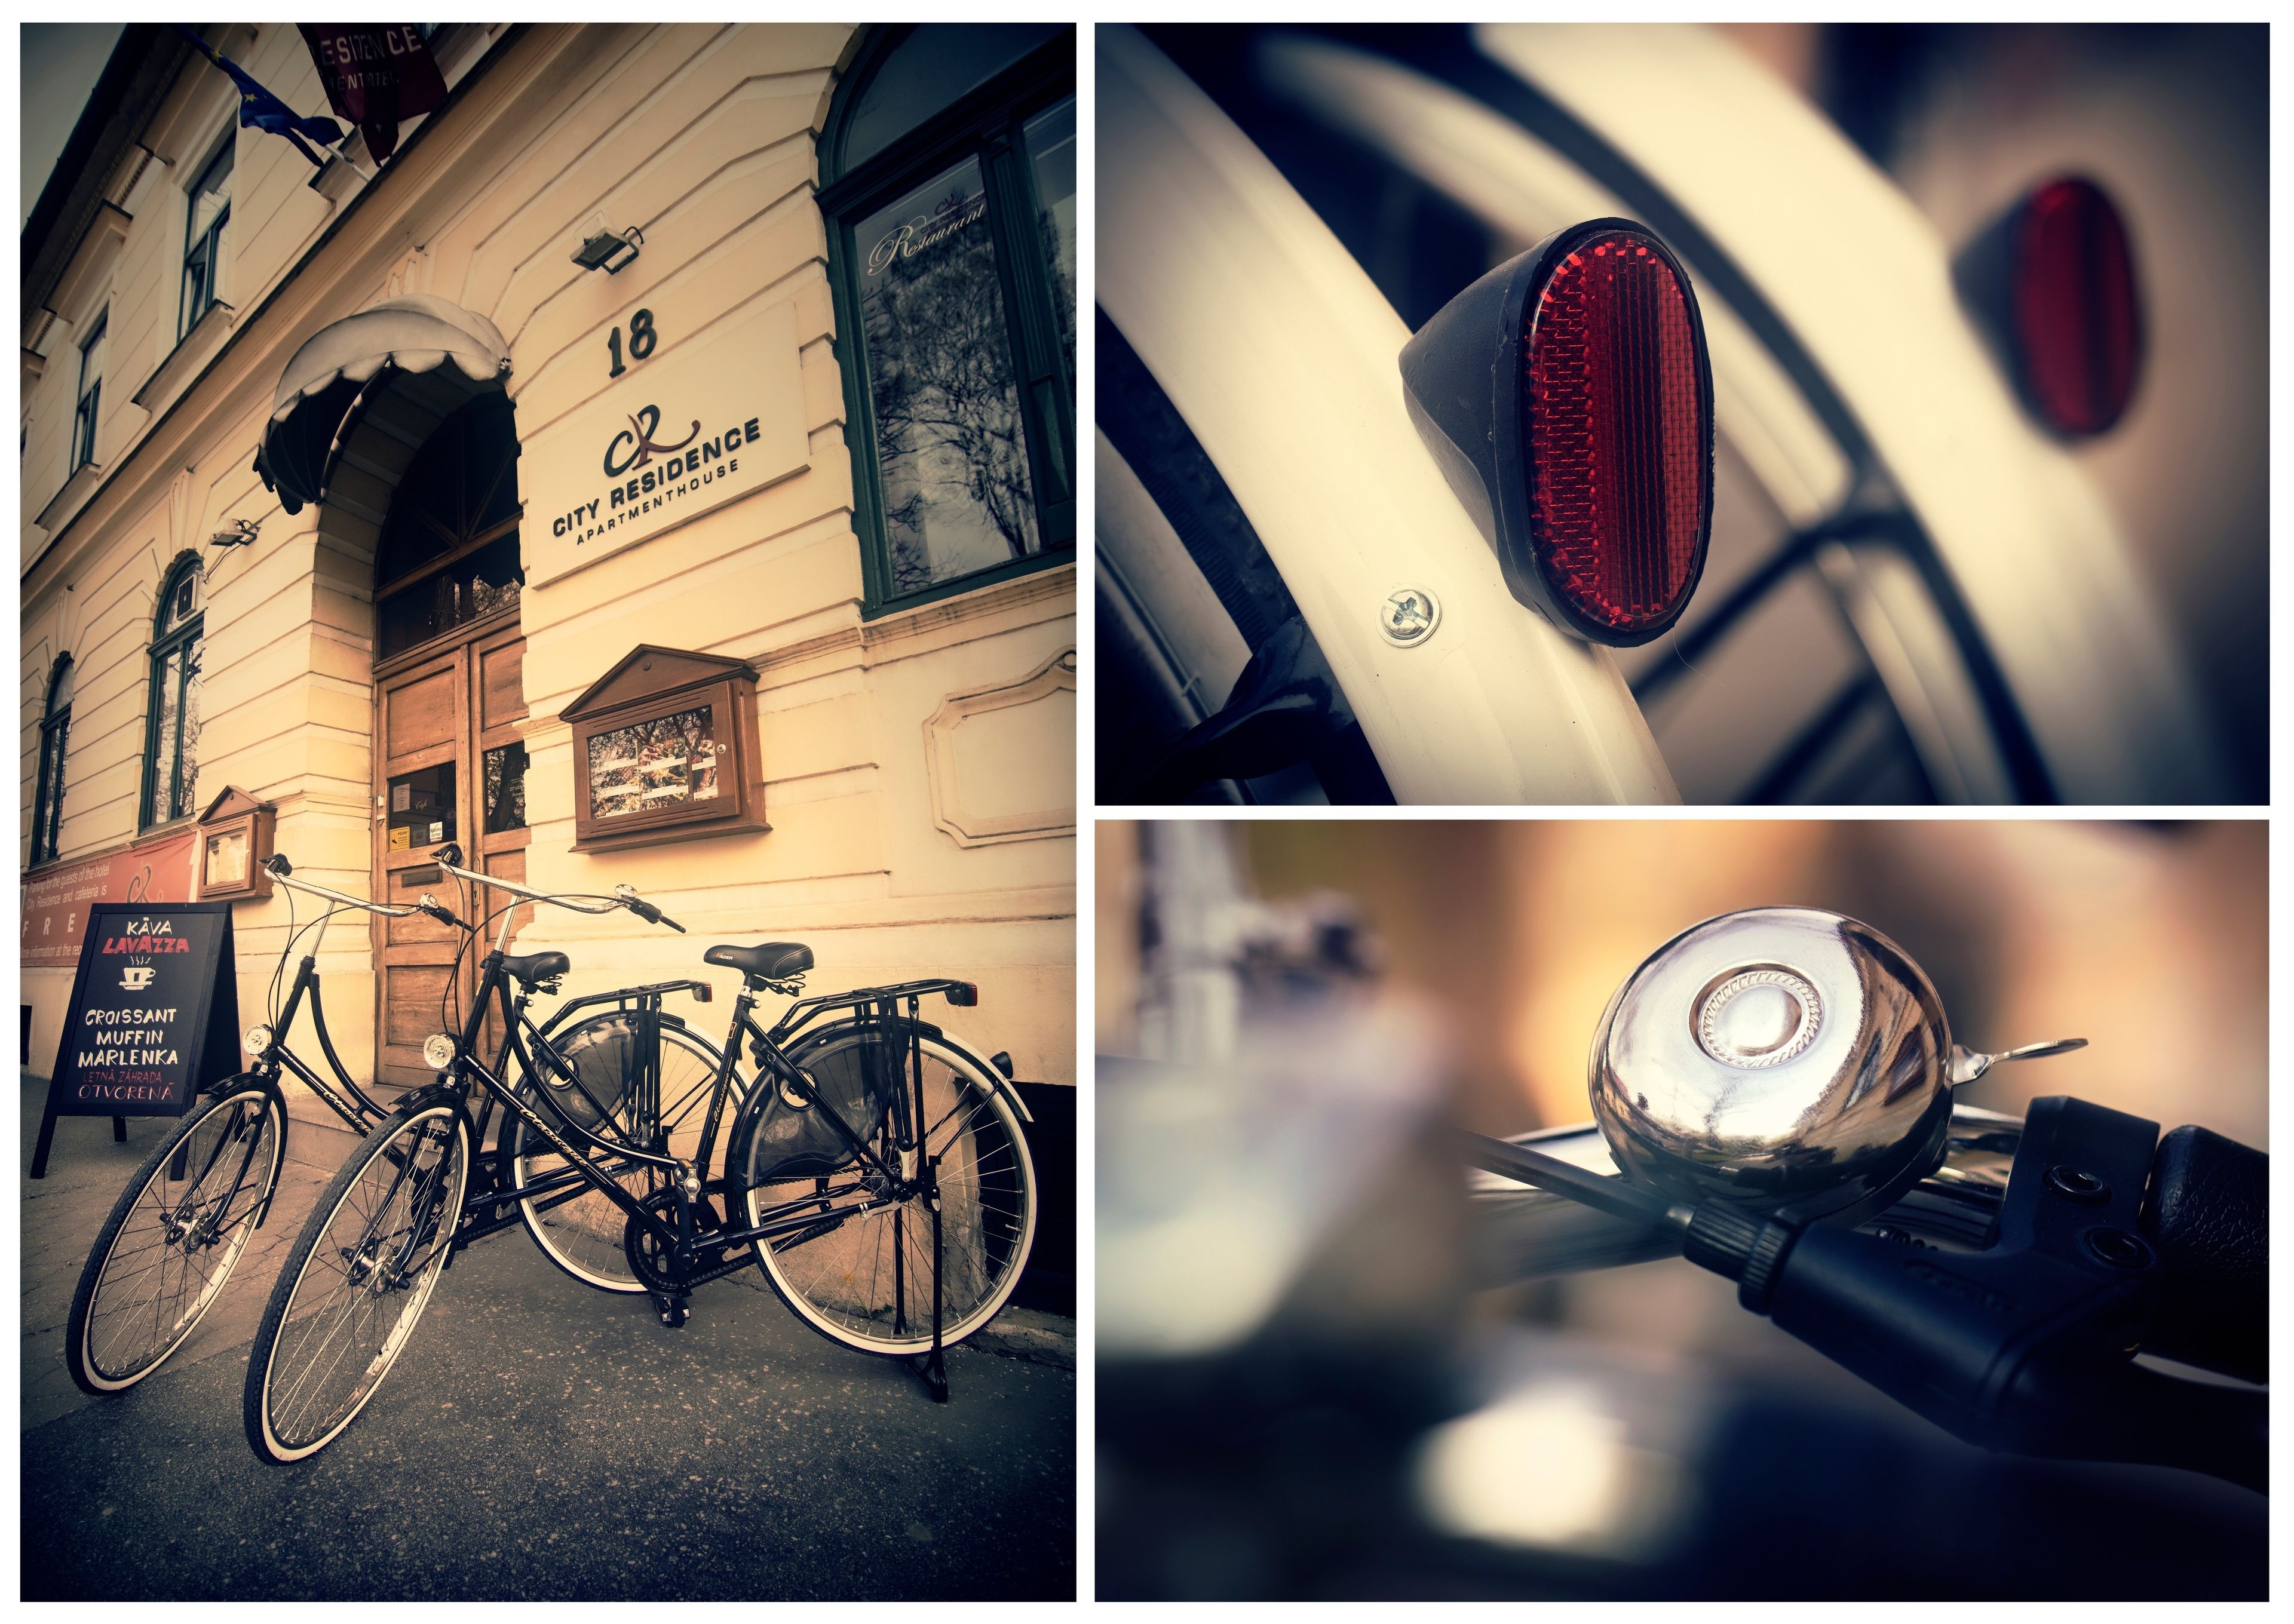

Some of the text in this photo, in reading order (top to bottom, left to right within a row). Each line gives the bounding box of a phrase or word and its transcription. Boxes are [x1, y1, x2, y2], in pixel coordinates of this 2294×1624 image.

[312, 26, 422, 66] ESIDENCE
[867, 203, 985, 276] Restaurant
[607, 308, 657, 378] 18
[553, 417, 760, 537] CITY RESIDENCE
[576, 459, 738, 545] APARTMENTHOUSE
[29, 880, 46, 894] Parking
[60, 871, 78, 889] guests
[78, 867, 85, 882] of
[85, 867, 94, 880] the
[95, 862, 110, 878] hotel
[27, 882, 107, 912] City Residence and cafeteria is
[30, 944, 55, 958] information
[56, 945, 62, 957] at
[62, 943, 71, 956] the
[102, 935, 190, 954] LAVAZZA
[85, 1008, 177, 1026] CROISSANT
[96, 1029, 163, 1045] MUFFIN
[78, 1049, 178, 1068] MARLENKA
[82, 1069, 162, 1084] LETNÁ ZÁHRADA
[78, 1082, 174, 1100] OTVORENÁ
